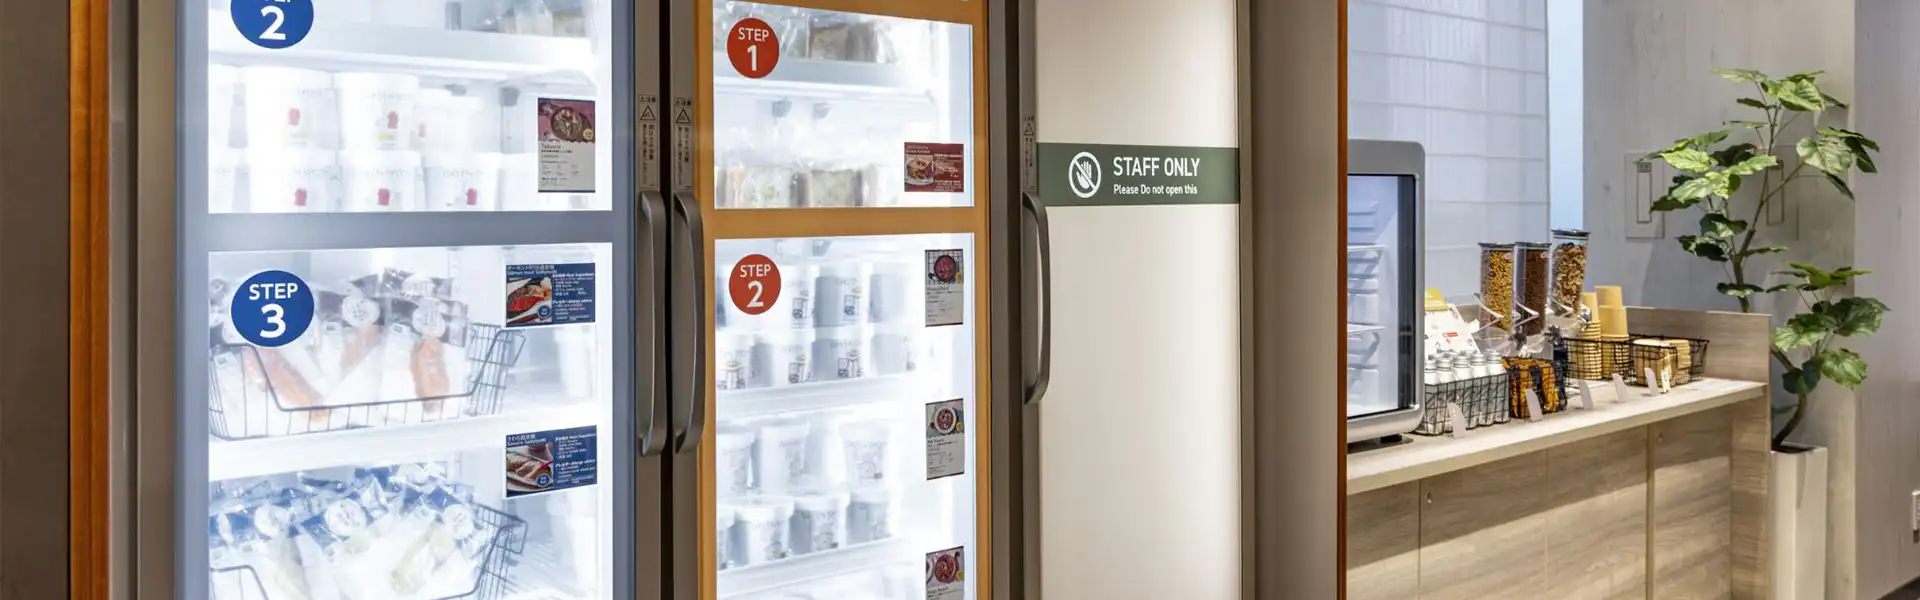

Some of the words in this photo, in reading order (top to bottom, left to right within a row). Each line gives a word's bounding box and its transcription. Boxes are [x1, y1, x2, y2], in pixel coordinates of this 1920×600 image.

[258, 5, 287, 41] 2
[737, 26, 770, 42] STEP
[747, 44, 757, 72] 1
[1113, 156, 1160, 177] STAFF
[1164, 157, 1200, 177] ONLY
[1113, 184, 1139, 195] Please
[1140, 184, 1151, 195] Do
[1152, 185, 1164, 195] not
[1165, 186, 1183, 197] open
[1184, 184, 1198, 195] this
[740, 263, 772, 278] STEP
[248, 282, 299, 301] STEP
[746, 280, 764, 308] 2
[259, 303, 287, 339] 3
